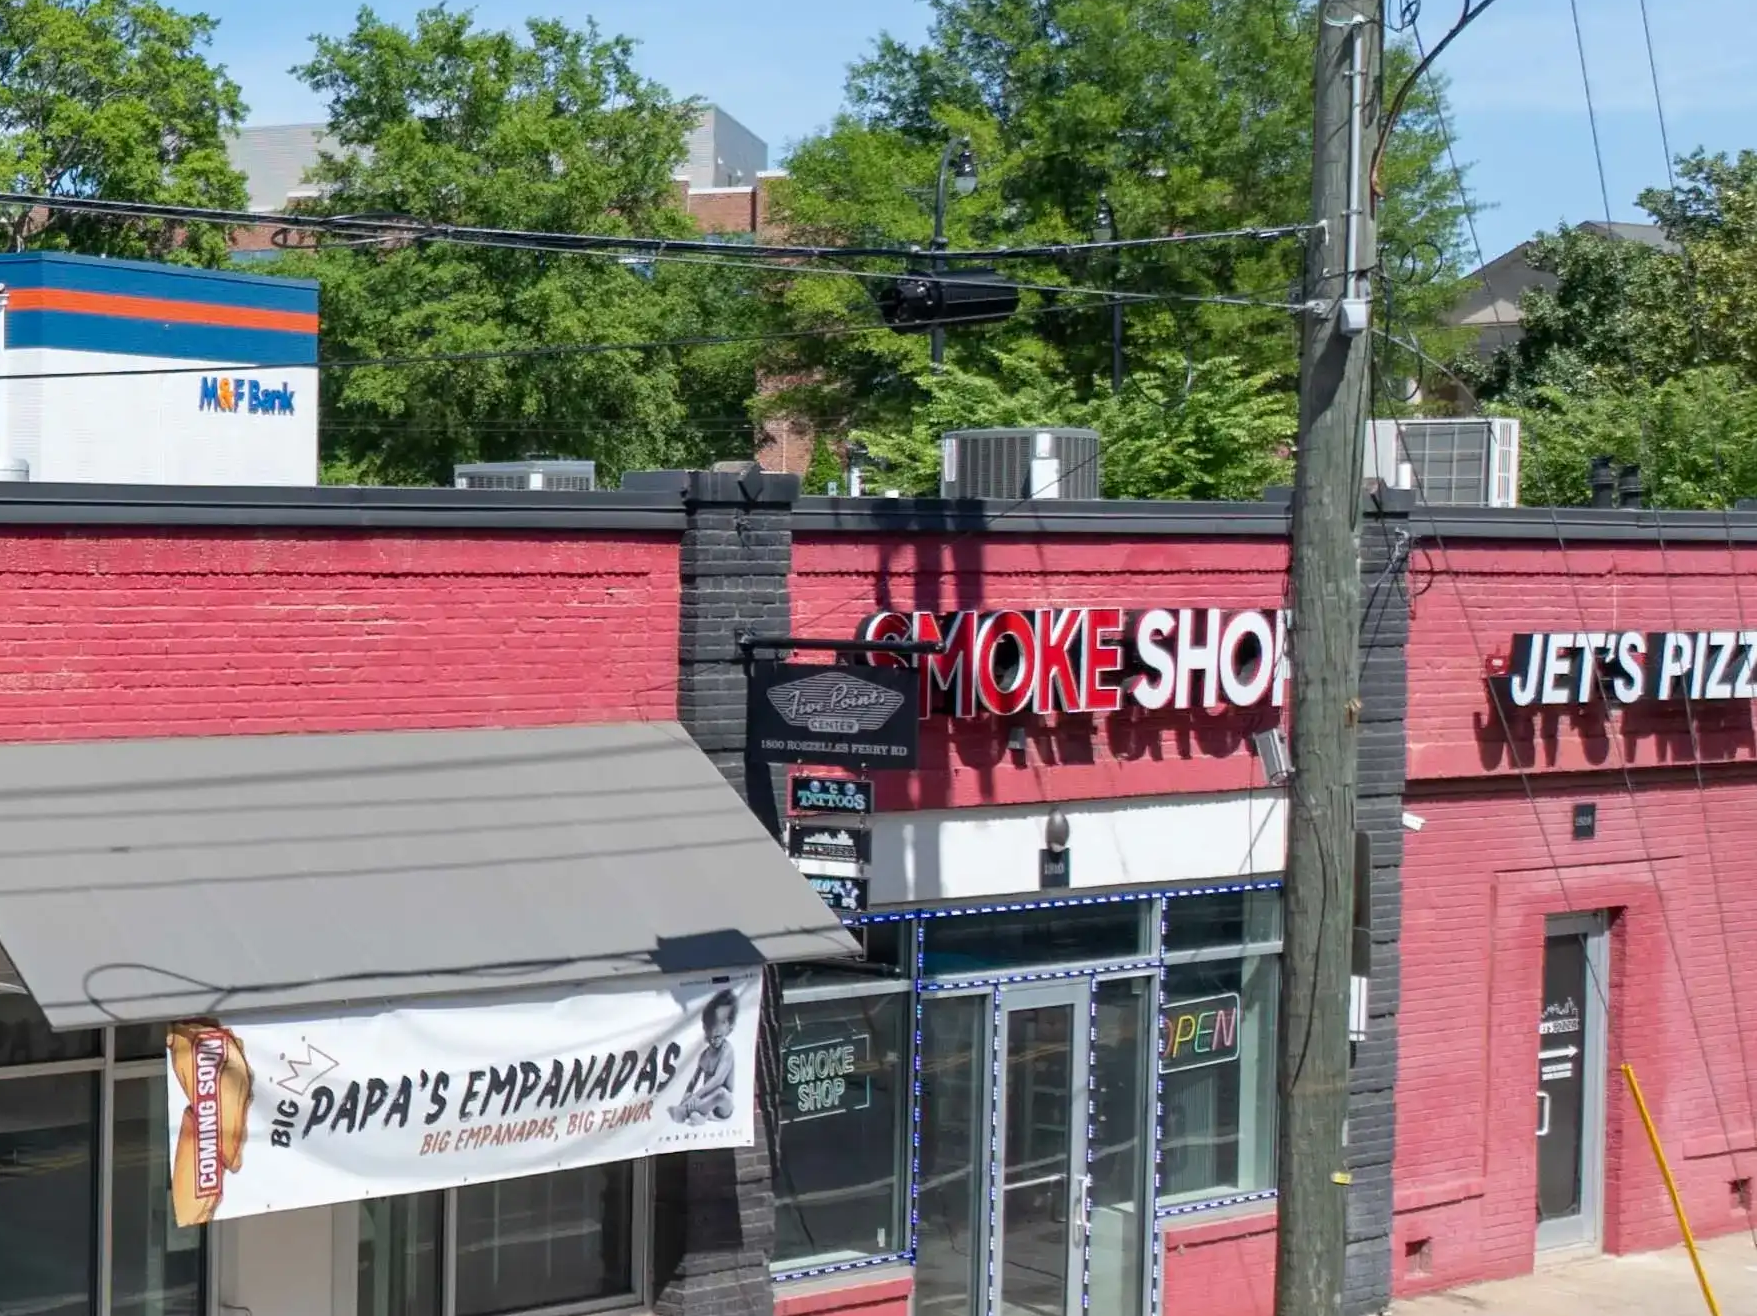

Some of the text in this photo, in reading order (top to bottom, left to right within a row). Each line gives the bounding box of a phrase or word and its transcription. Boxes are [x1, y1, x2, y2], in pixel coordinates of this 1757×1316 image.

[199, 377, 296, 415] M&F Bank
[1510, 631, 1648, 706] JET'S
[761, 739, 785, 750] 1800
[851, 744, 888, 755] FERRY
[891, 746, 908, 756] RD
[797, 790, 866, 810] TATTOOS
[787, 1046, 854, 1084] SMOKE
[197, 1037, 224, 1189] COMING SOON
[271, 1042, 681, 1148] BIG PAPA'S EMPANADAS
[798, 1078, 845, 1112] SHOP
[419, 1100, 655, 1156] BIG EMPANADAS, BIG FLAVOR
